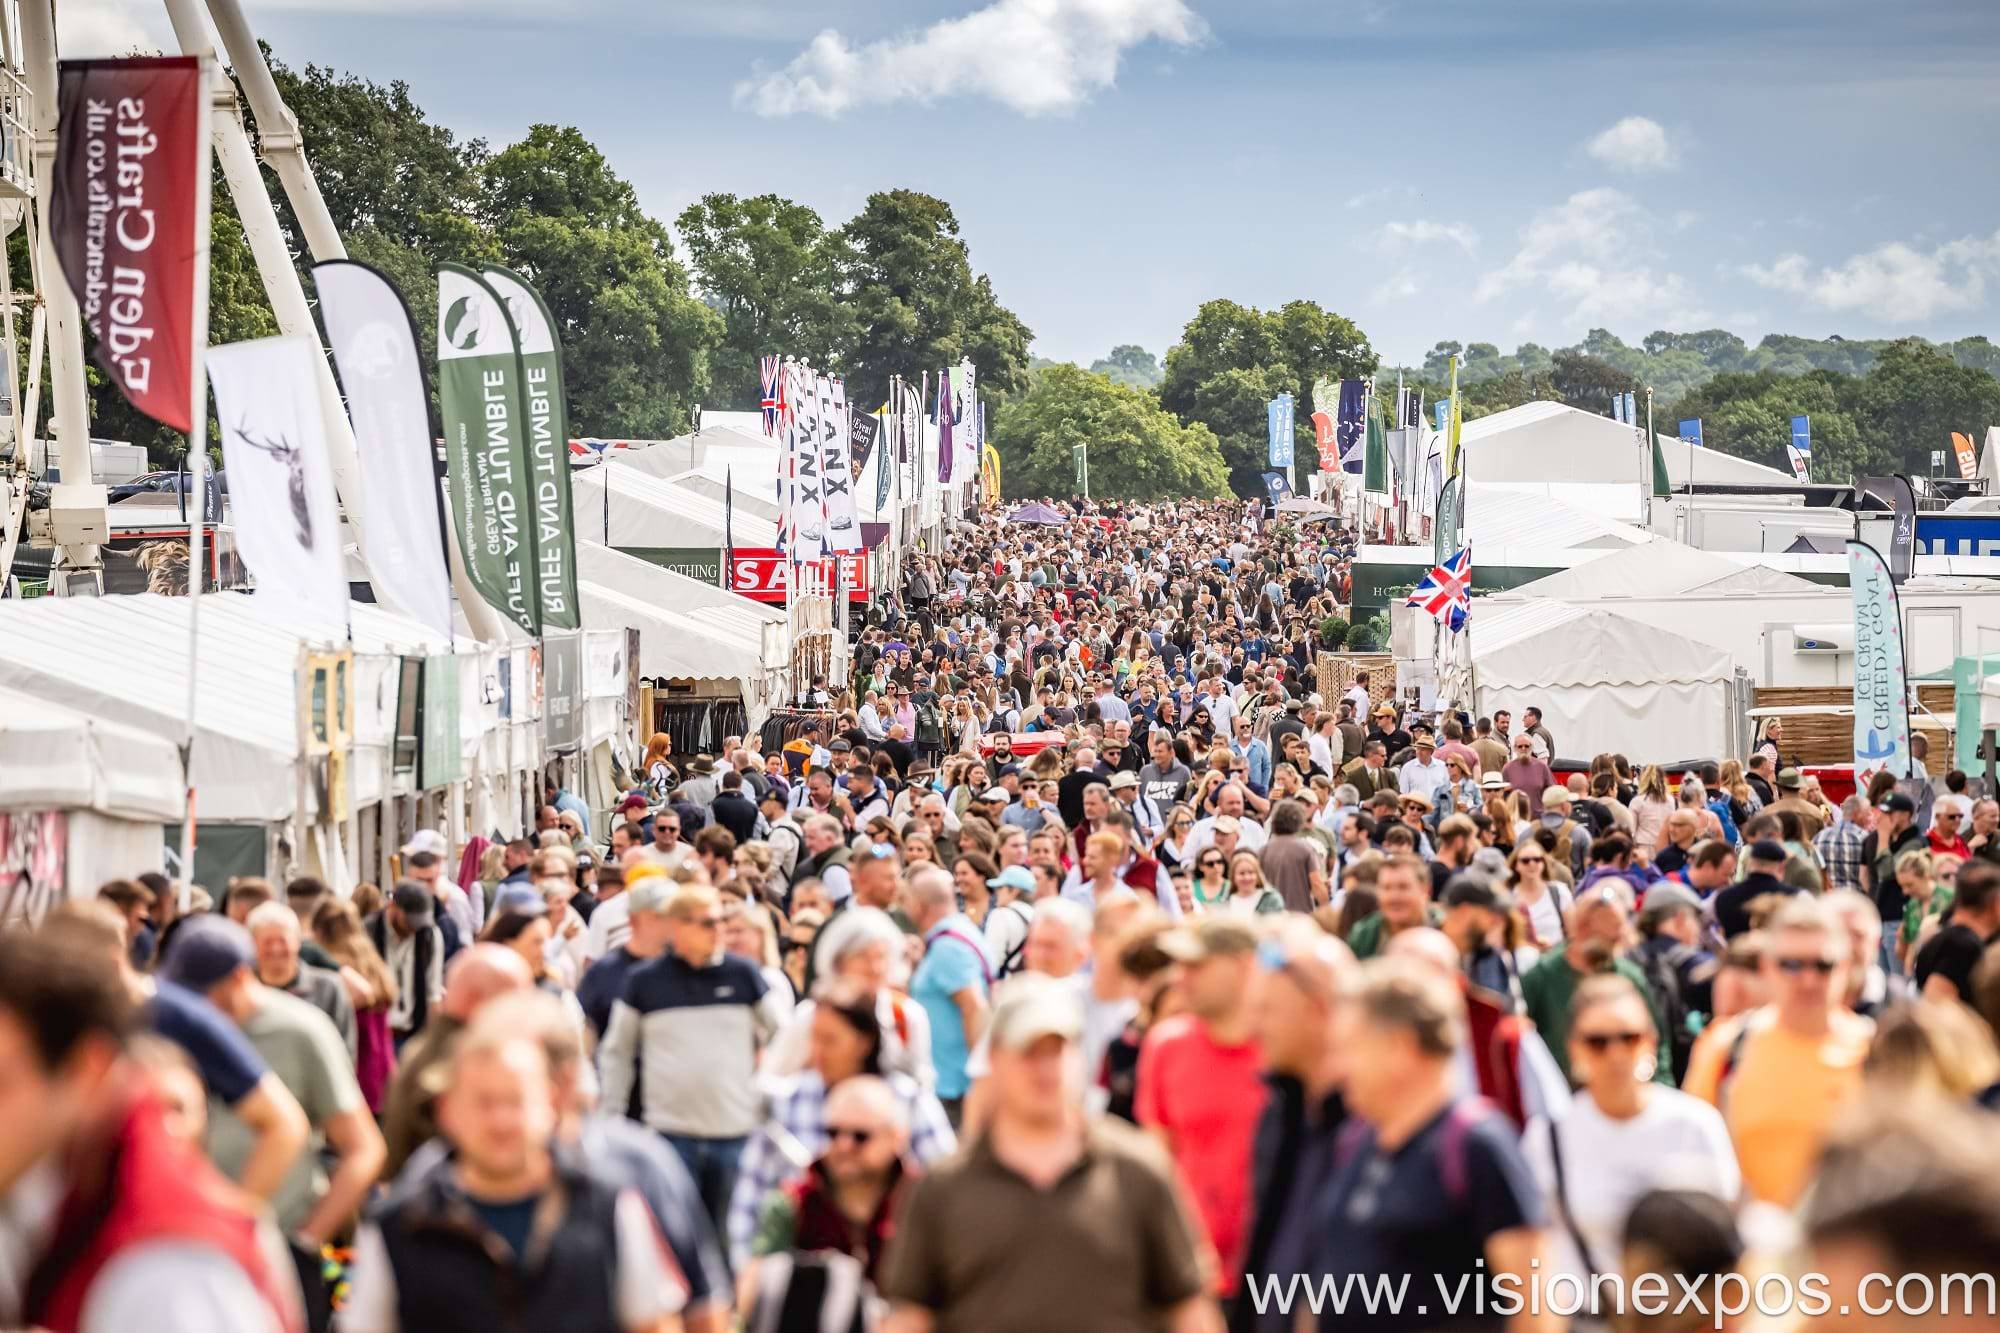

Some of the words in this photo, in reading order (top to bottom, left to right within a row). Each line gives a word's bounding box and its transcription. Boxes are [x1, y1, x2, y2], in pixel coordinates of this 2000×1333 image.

[822, 398, 849, 497] LANX
[661, 564, 718, 578] OTHING
[736, 560, 858, 589] SAE
